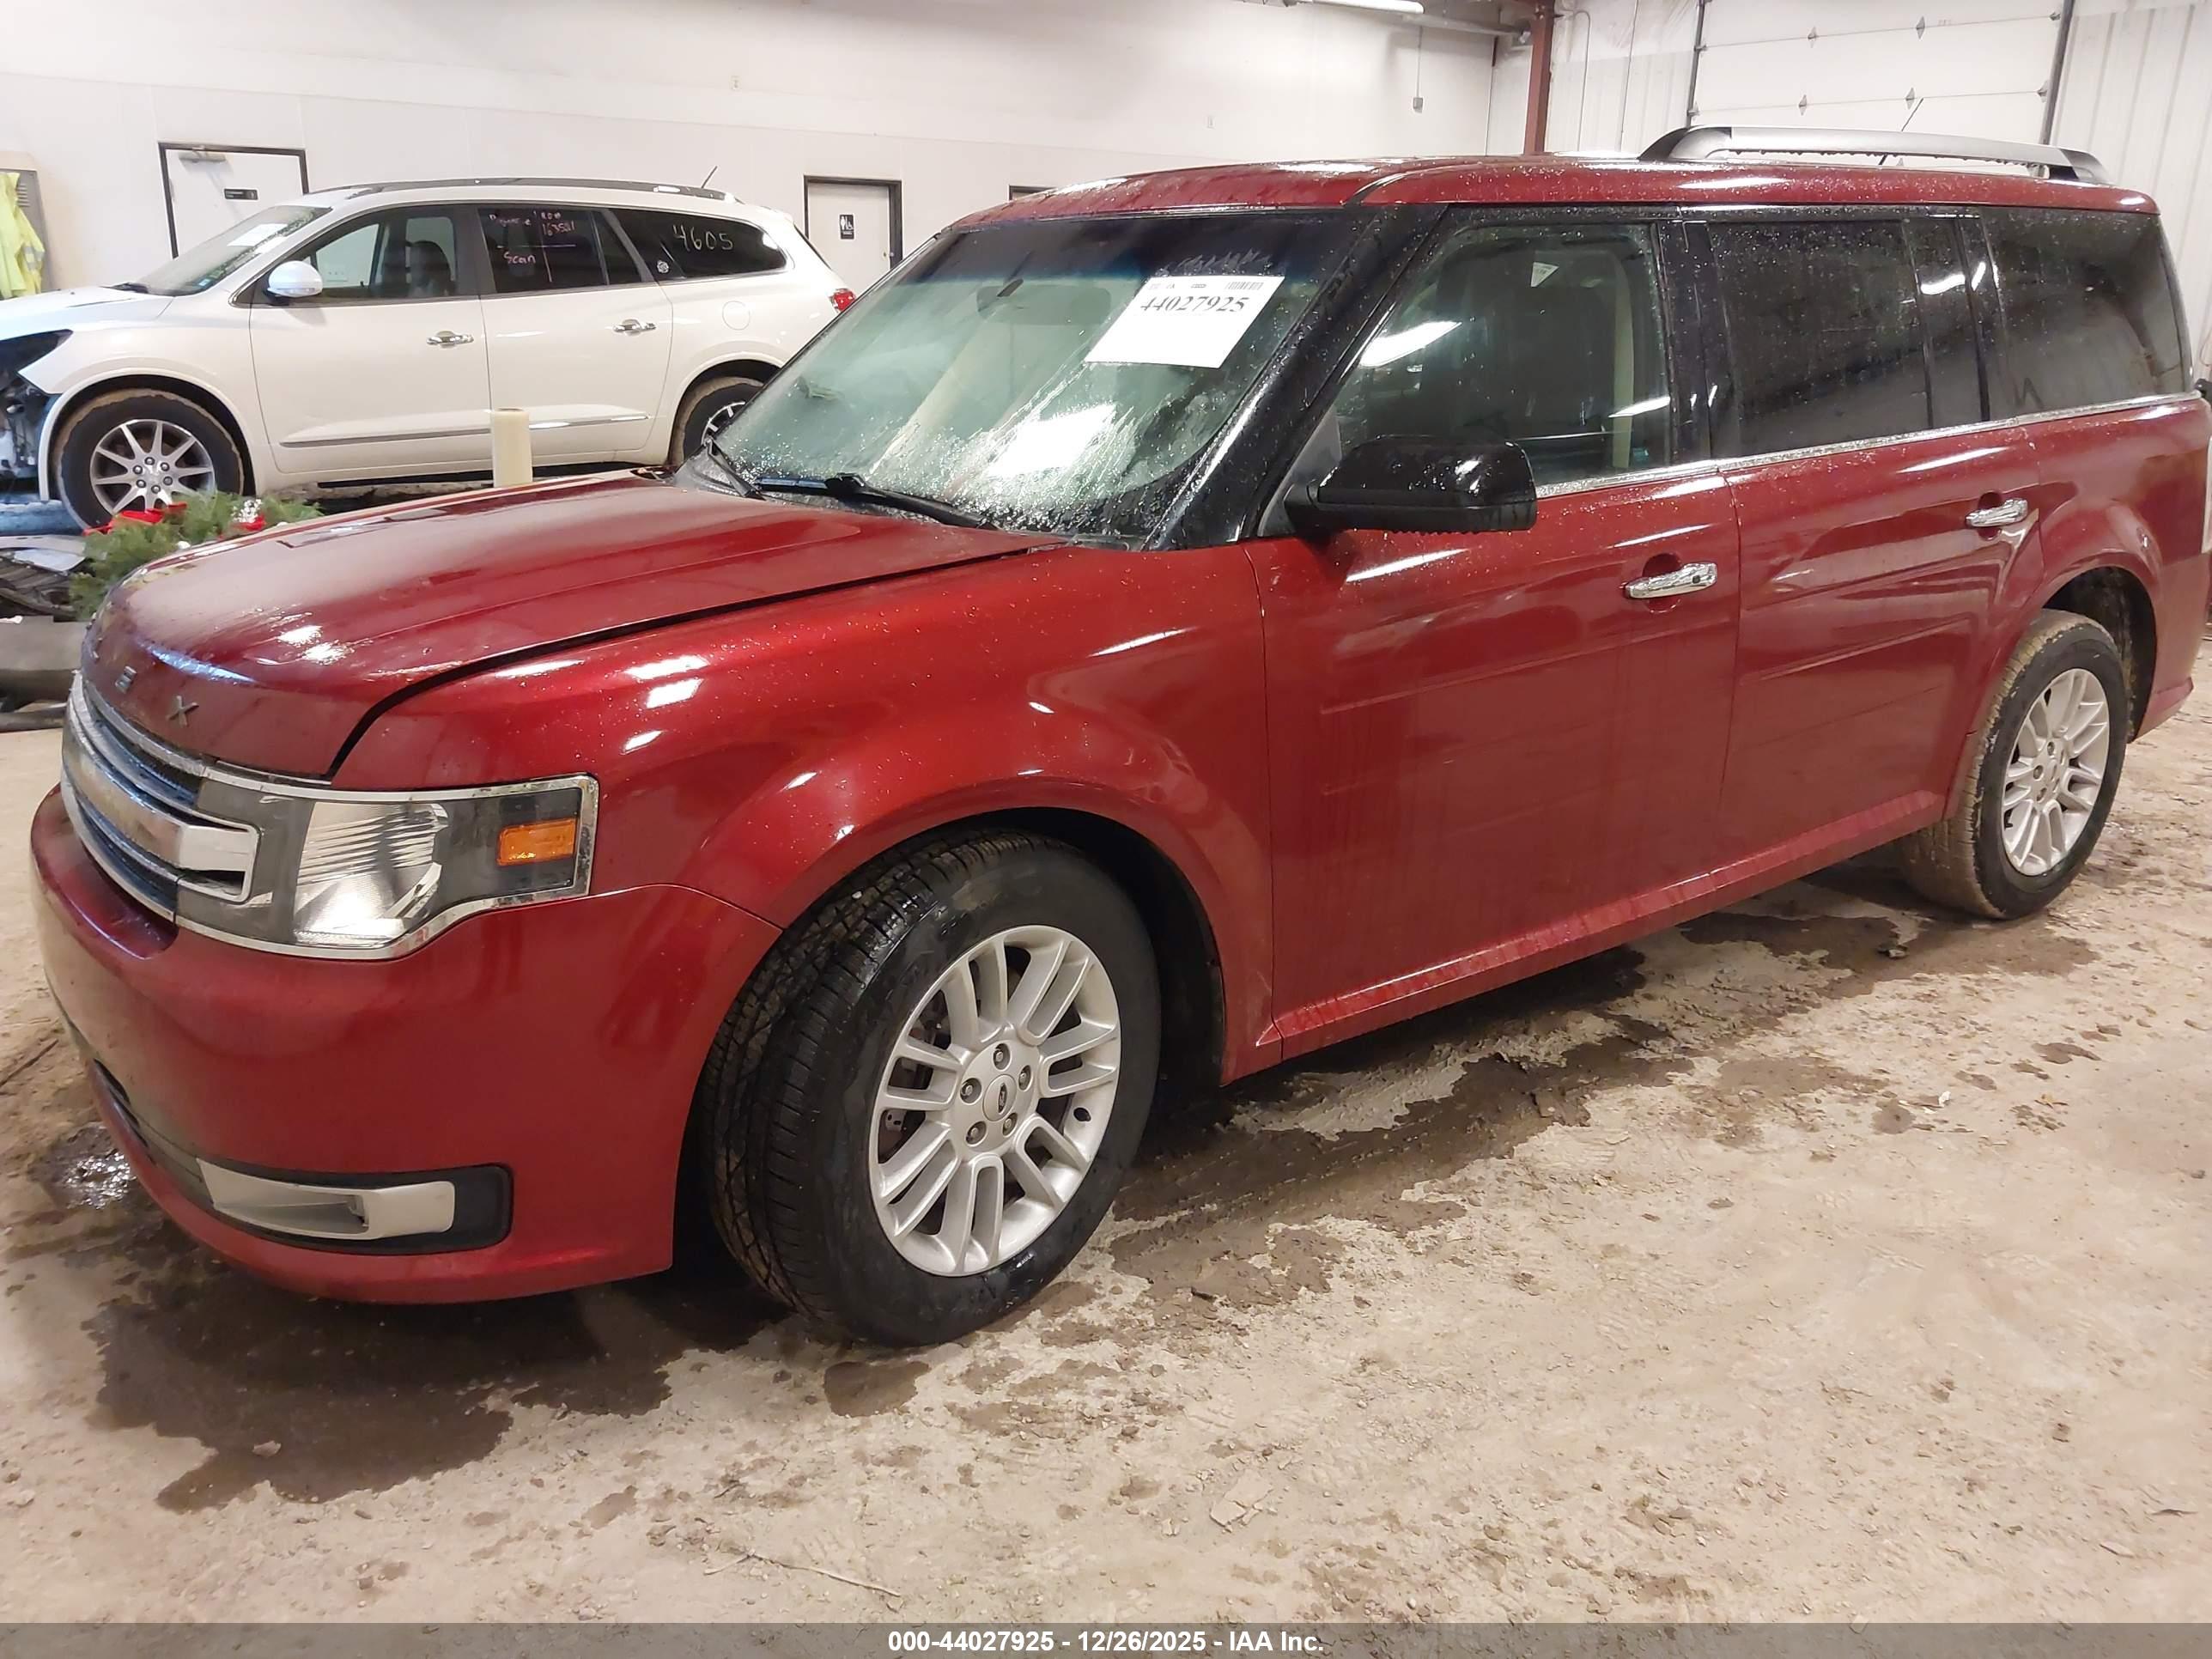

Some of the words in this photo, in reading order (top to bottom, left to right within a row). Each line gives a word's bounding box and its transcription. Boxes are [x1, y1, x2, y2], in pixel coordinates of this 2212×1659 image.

[673, 224, 734, 252] 4605
[503, 252, 536, 264] Scan
[1140, 295, 1249, 312] 44027925
